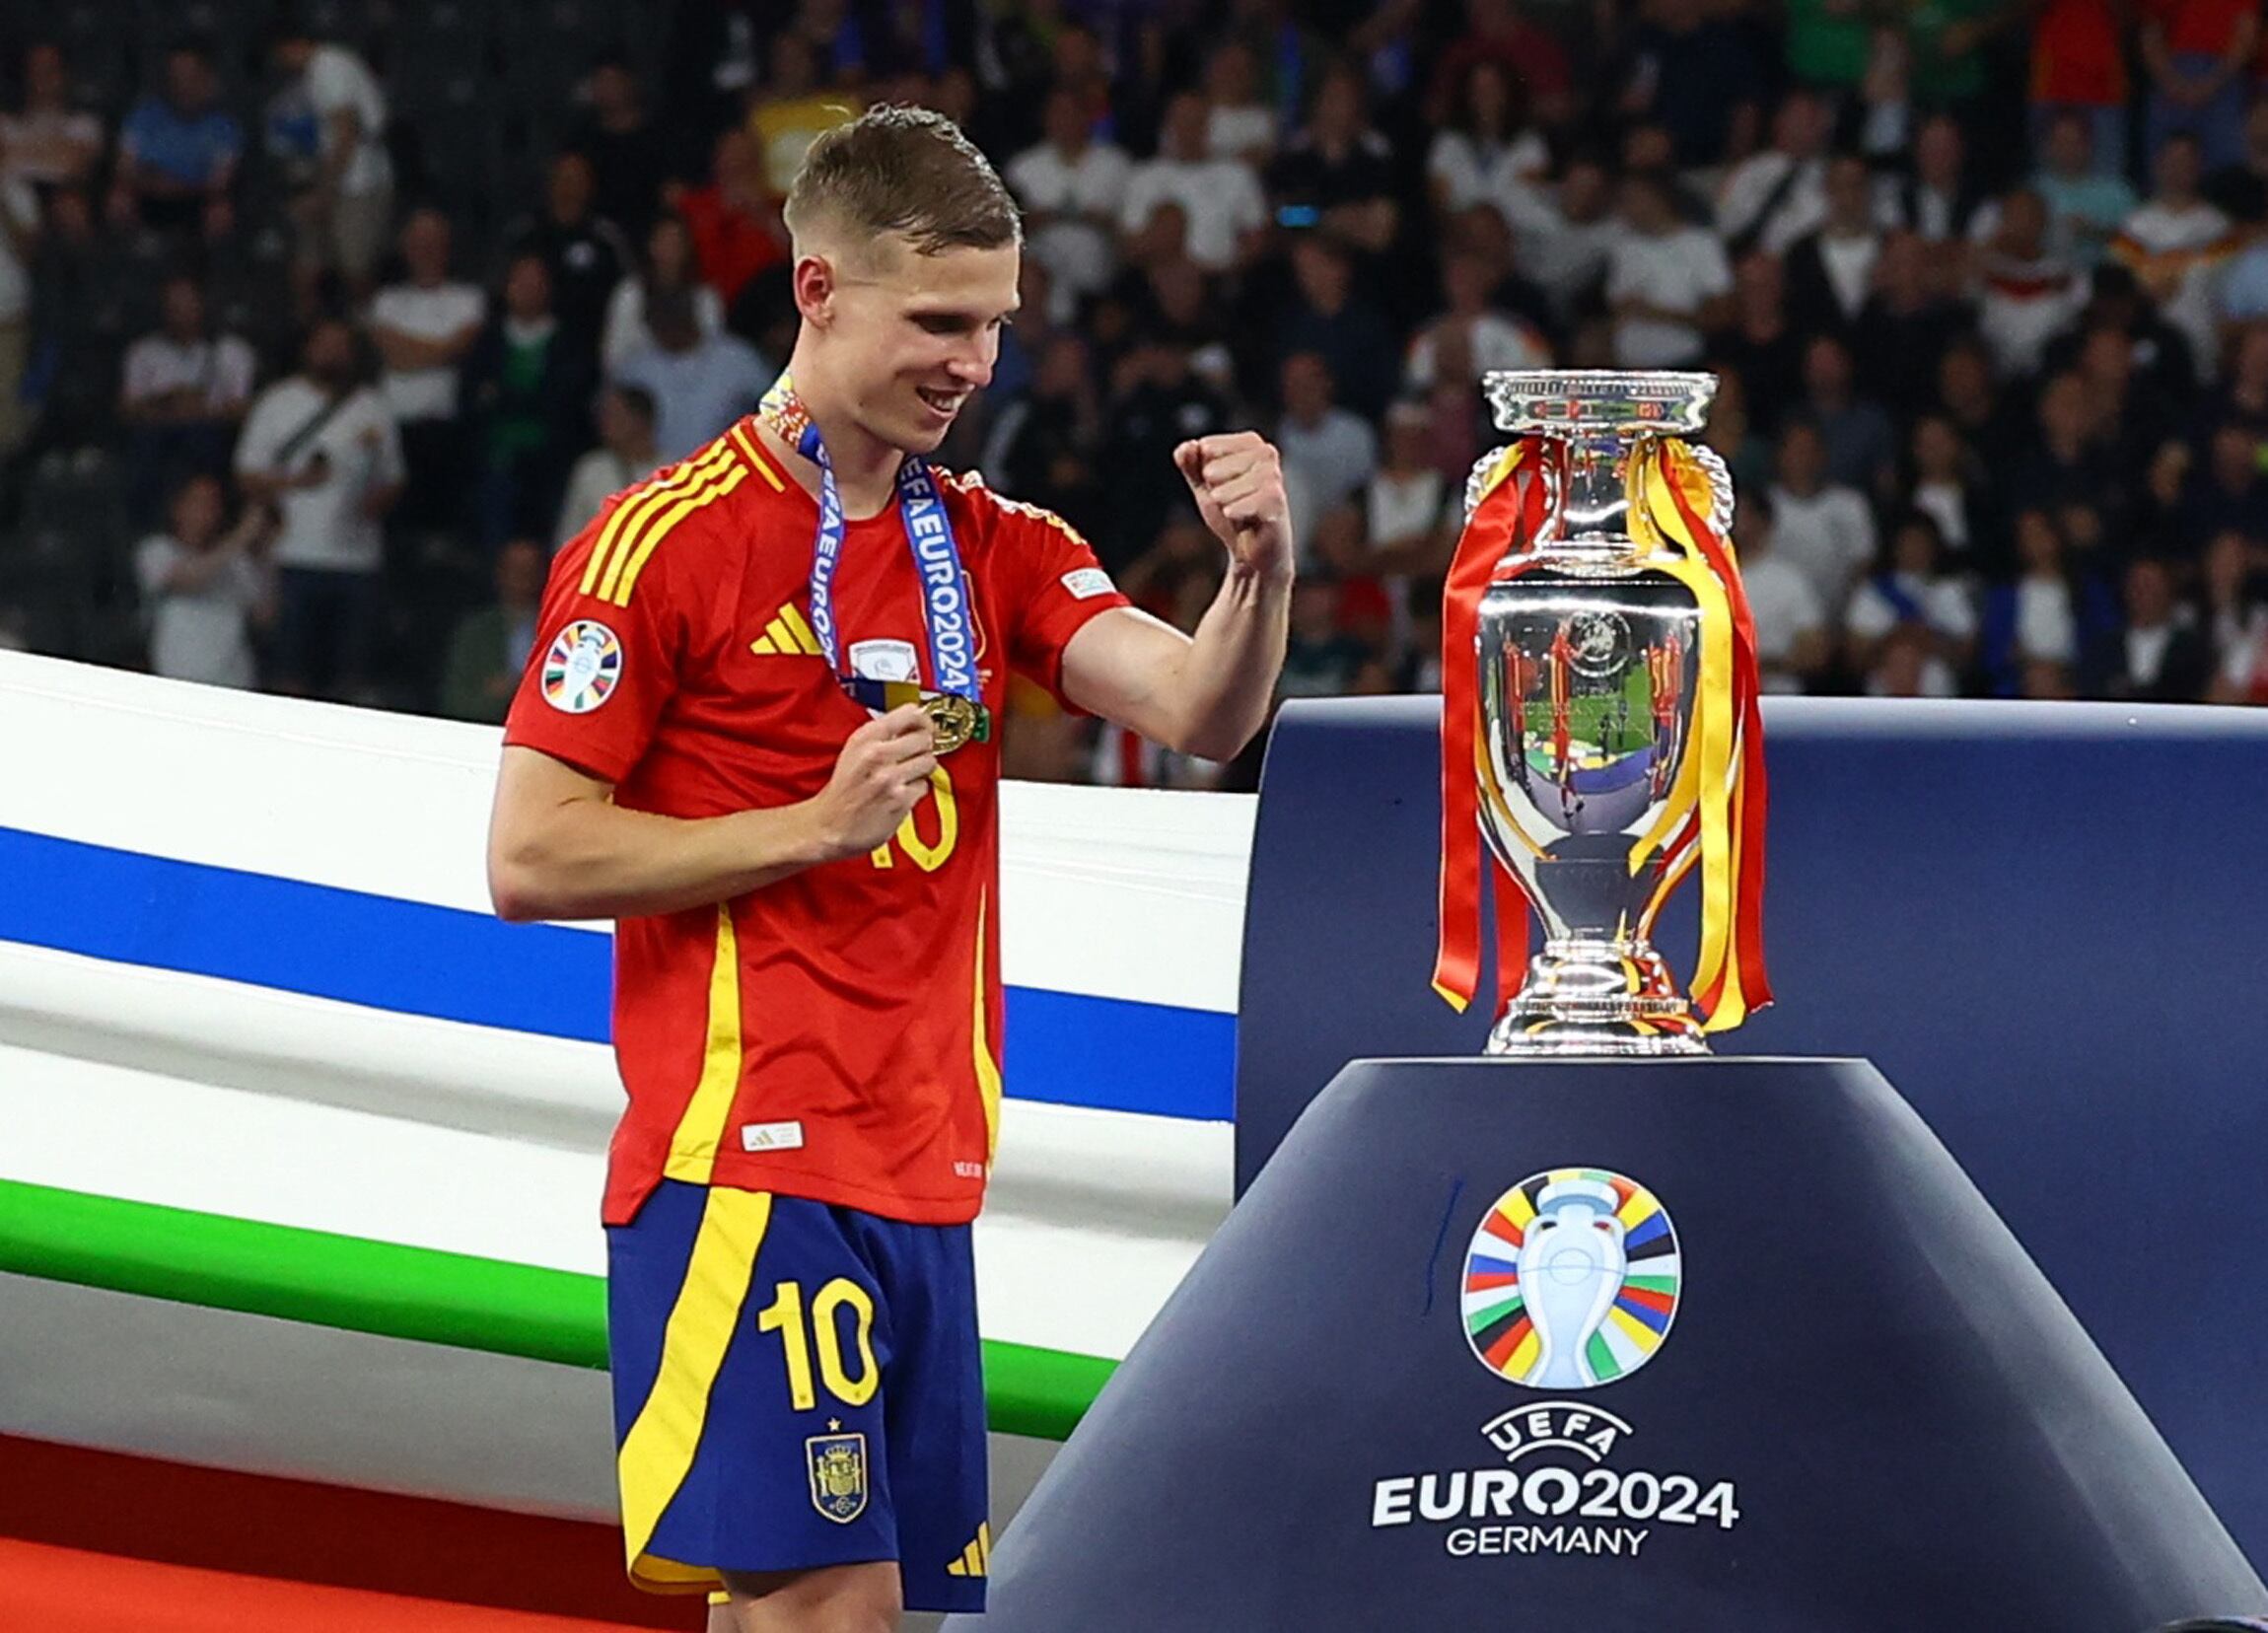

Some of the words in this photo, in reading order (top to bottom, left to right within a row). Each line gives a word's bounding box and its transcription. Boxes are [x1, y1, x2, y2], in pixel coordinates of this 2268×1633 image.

[900, 457, 934, 518] EFA
[911, 514, 970, 689] EURO2024
[871, 762, 958, 872] 0
[758, 1277, 879, 1410] 10
[1488, 1411, 1617, 1455] UEFA
[1372, 1466, 1740, 1529] EURO2024
[1446, 1526, 1649, 1556] GERMANY
